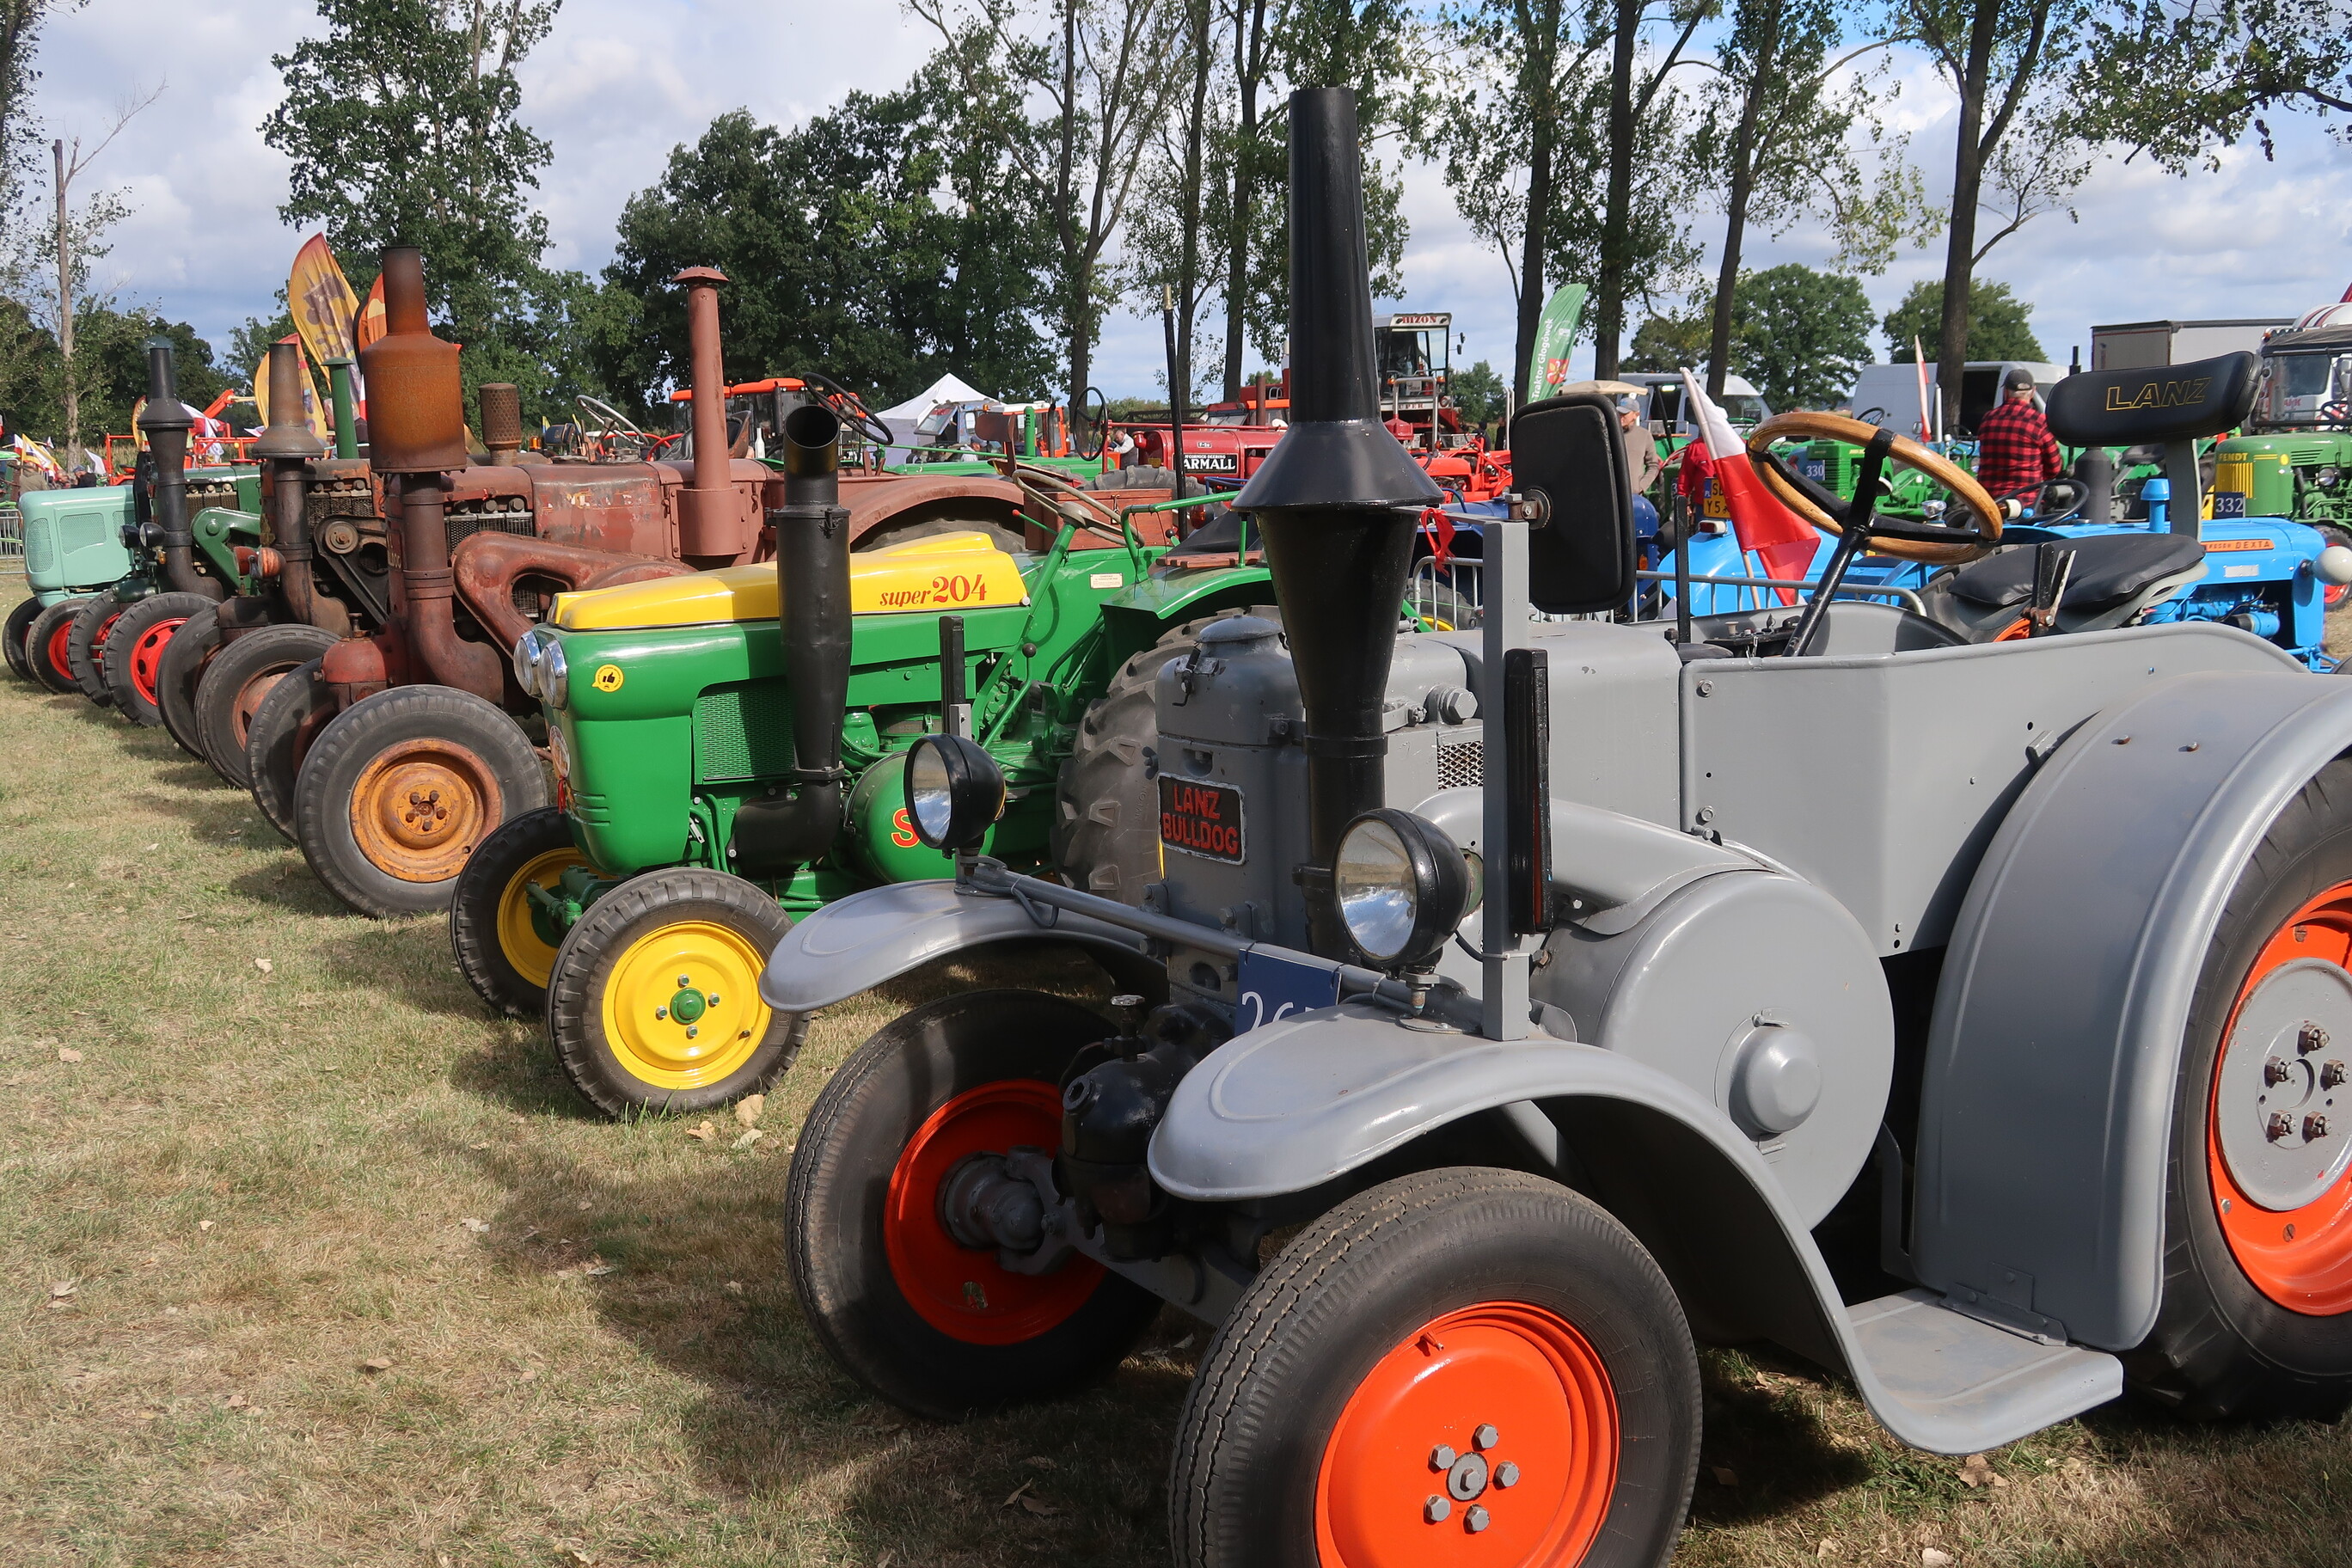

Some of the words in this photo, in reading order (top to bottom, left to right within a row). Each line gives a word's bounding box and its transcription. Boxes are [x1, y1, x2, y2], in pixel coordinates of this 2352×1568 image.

[1402, 315, 1437, 324] BIZON
[1531, 364, 1544, 399] Traktor
[2106, 377, 2212, 411] LANZ
[1183, 458, 1236, 470] ARMALL
[2219, 452, 2249, 462] FENDT
[1806, 464, 1824, 477] 330
[2215, 497, 2244, 513] 332
[2235, 541, 2270, 549] DEXTA
[879, 590, 931, 608] super
[932, 574, 987, 603] 204
[1173, 783, 1221, 819] LANZ
[1162, 812, 1239, 854] BULLDOG
